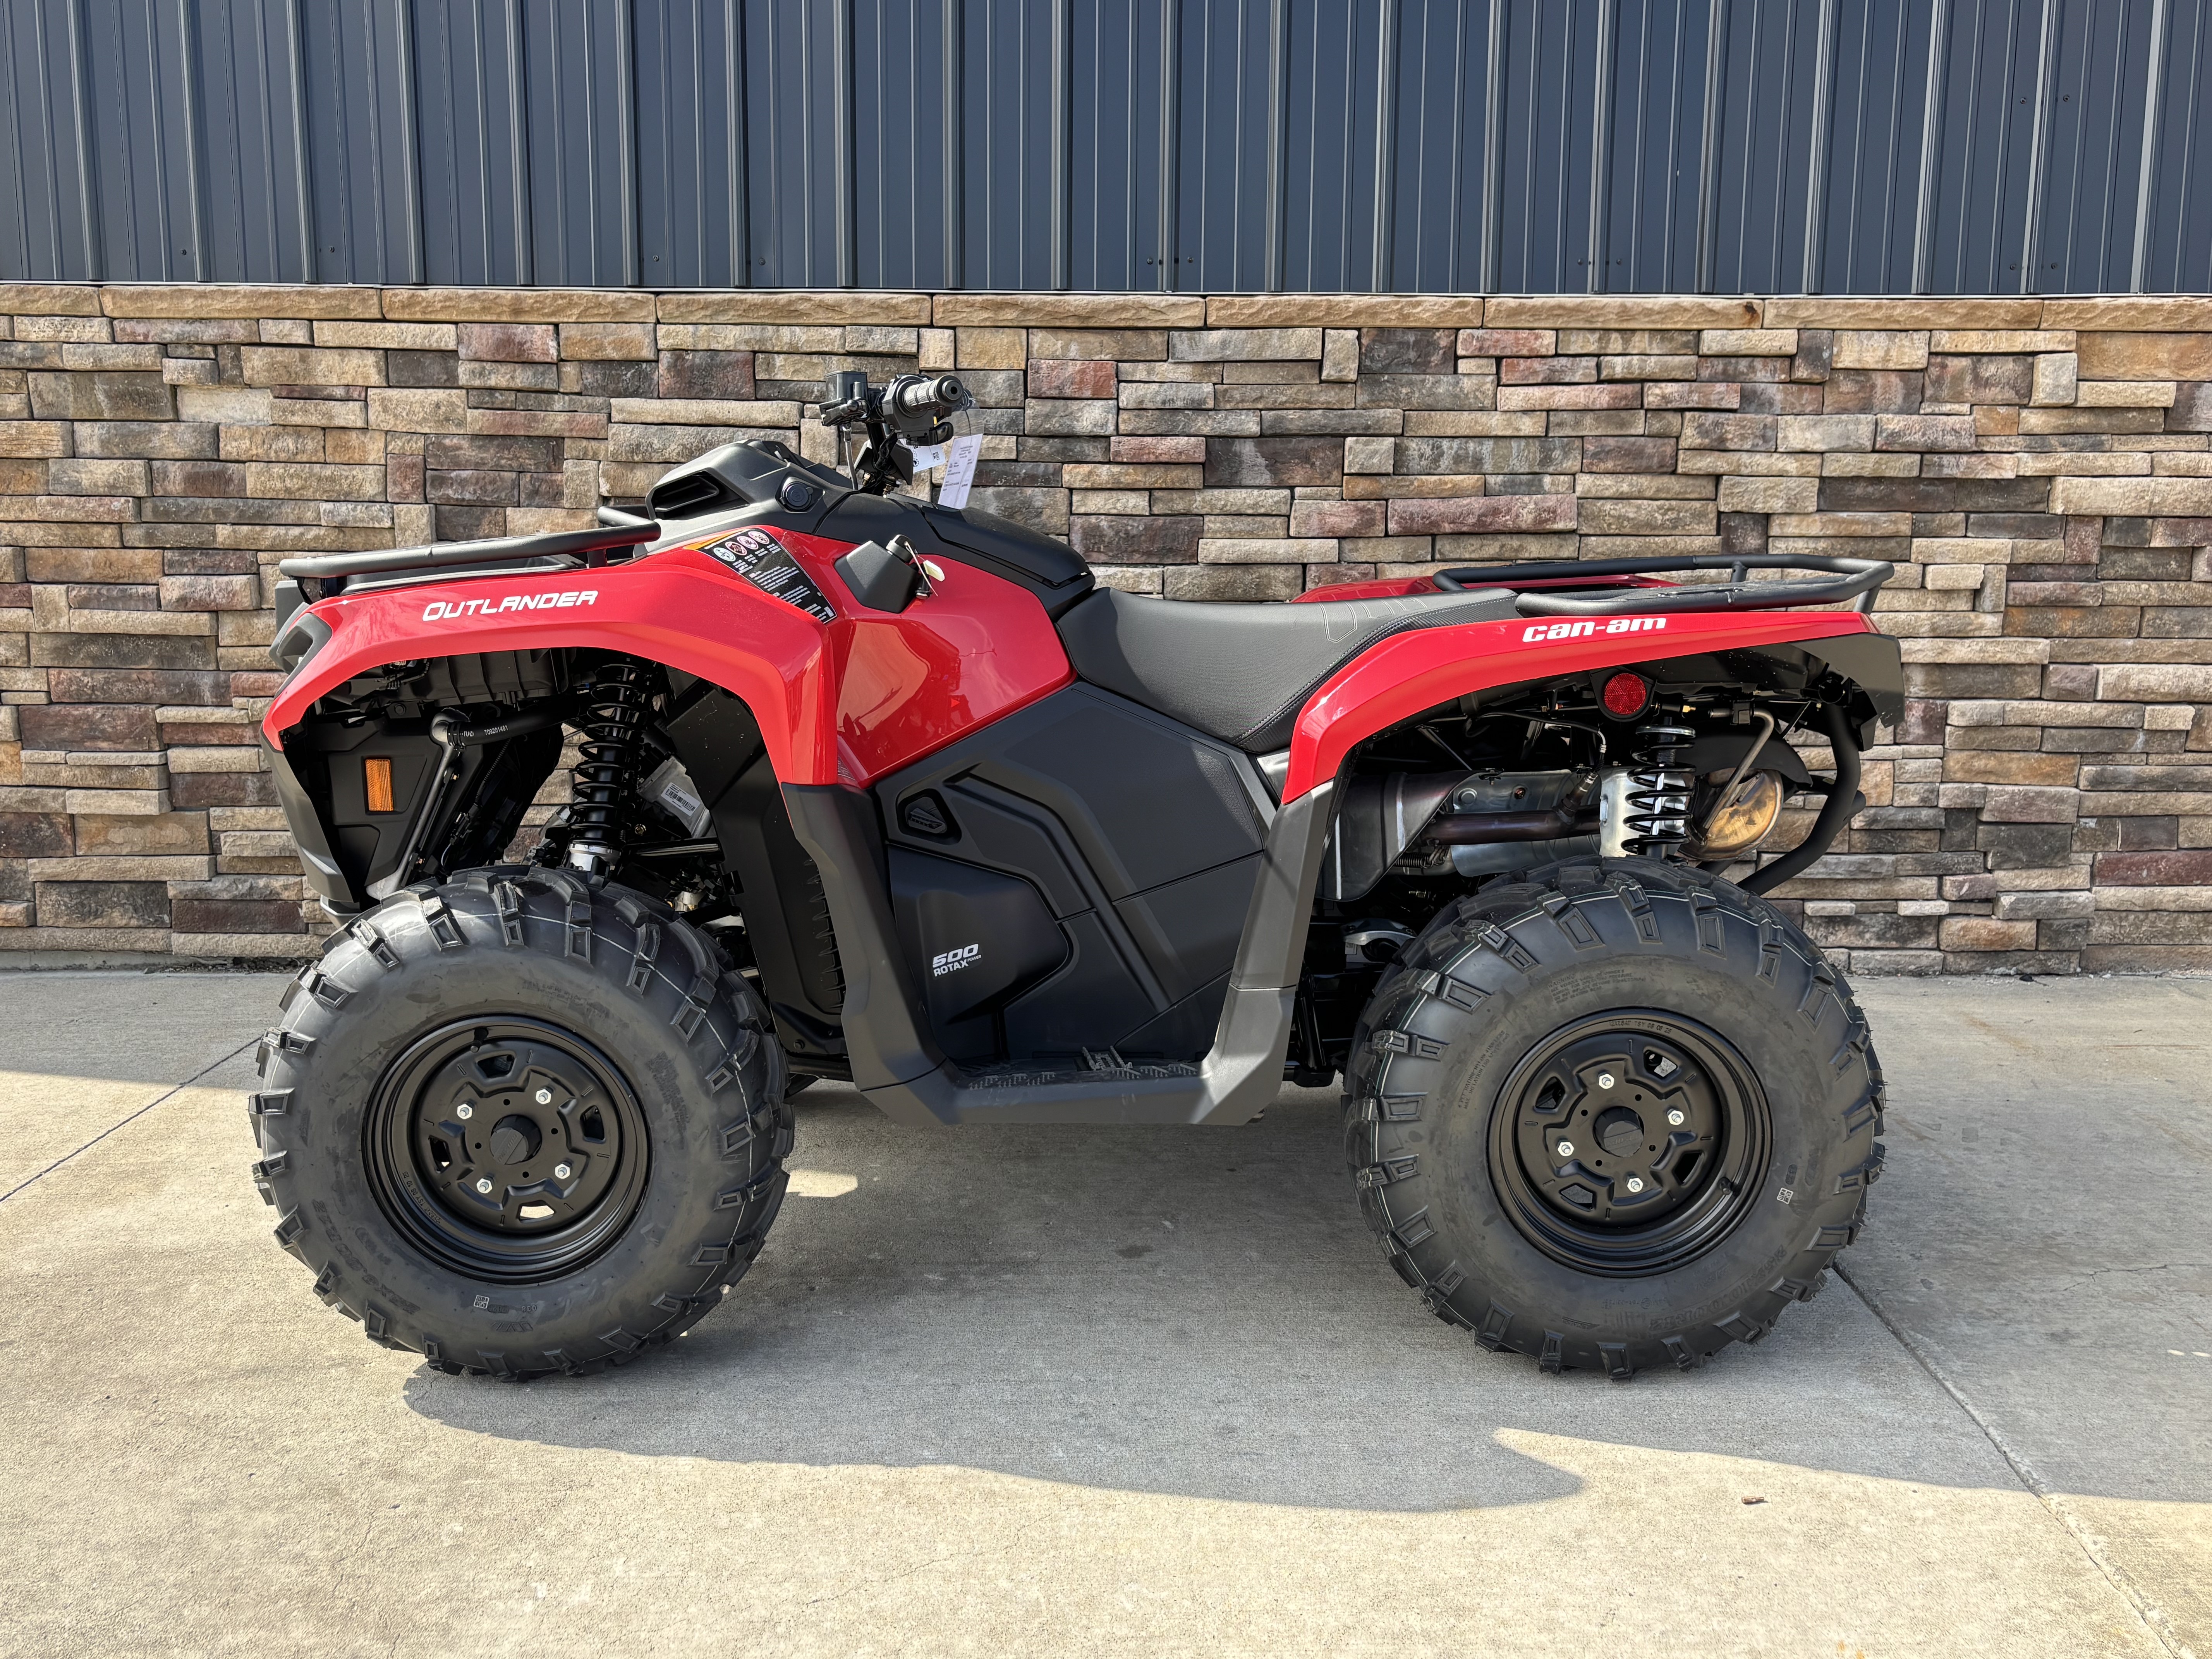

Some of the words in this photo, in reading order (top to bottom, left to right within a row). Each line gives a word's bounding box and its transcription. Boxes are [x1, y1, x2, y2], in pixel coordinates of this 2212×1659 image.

[422, 590, 598, 621] OUTLANDER
[1522, 617, 1667, 642] can-am
[933, 944, 979, 968] 500
[934, 959, 969, 977] ROTAX
